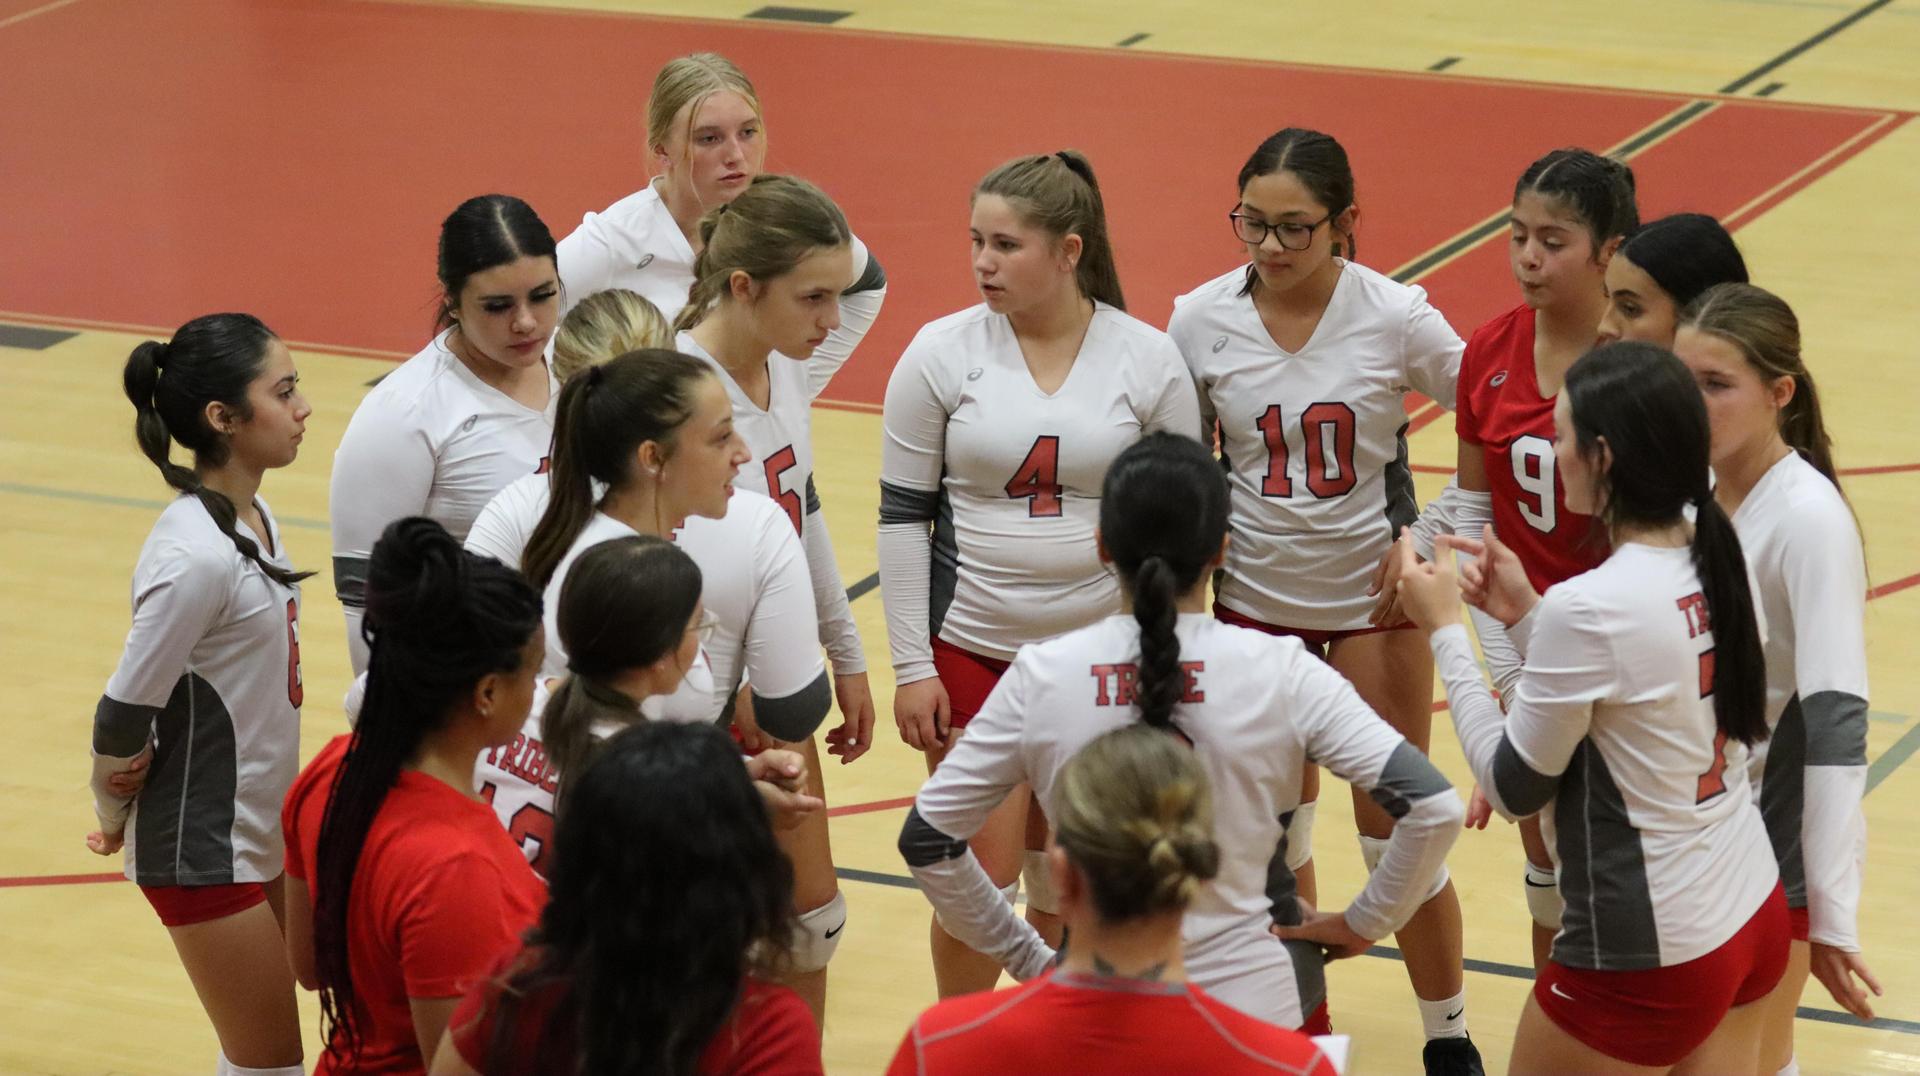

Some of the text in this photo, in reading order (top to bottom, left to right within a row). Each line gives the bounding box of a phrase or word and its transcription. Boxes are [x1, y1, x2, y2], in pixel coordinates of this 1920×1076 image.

[763, 443, 802, 539] 5
[1004, 435, 1063, 517] 4
[1256, 402, 1357, 499] 10
[1511, 434, 1557, 534] 9
[1091, 661, 1205, 706] TRE
